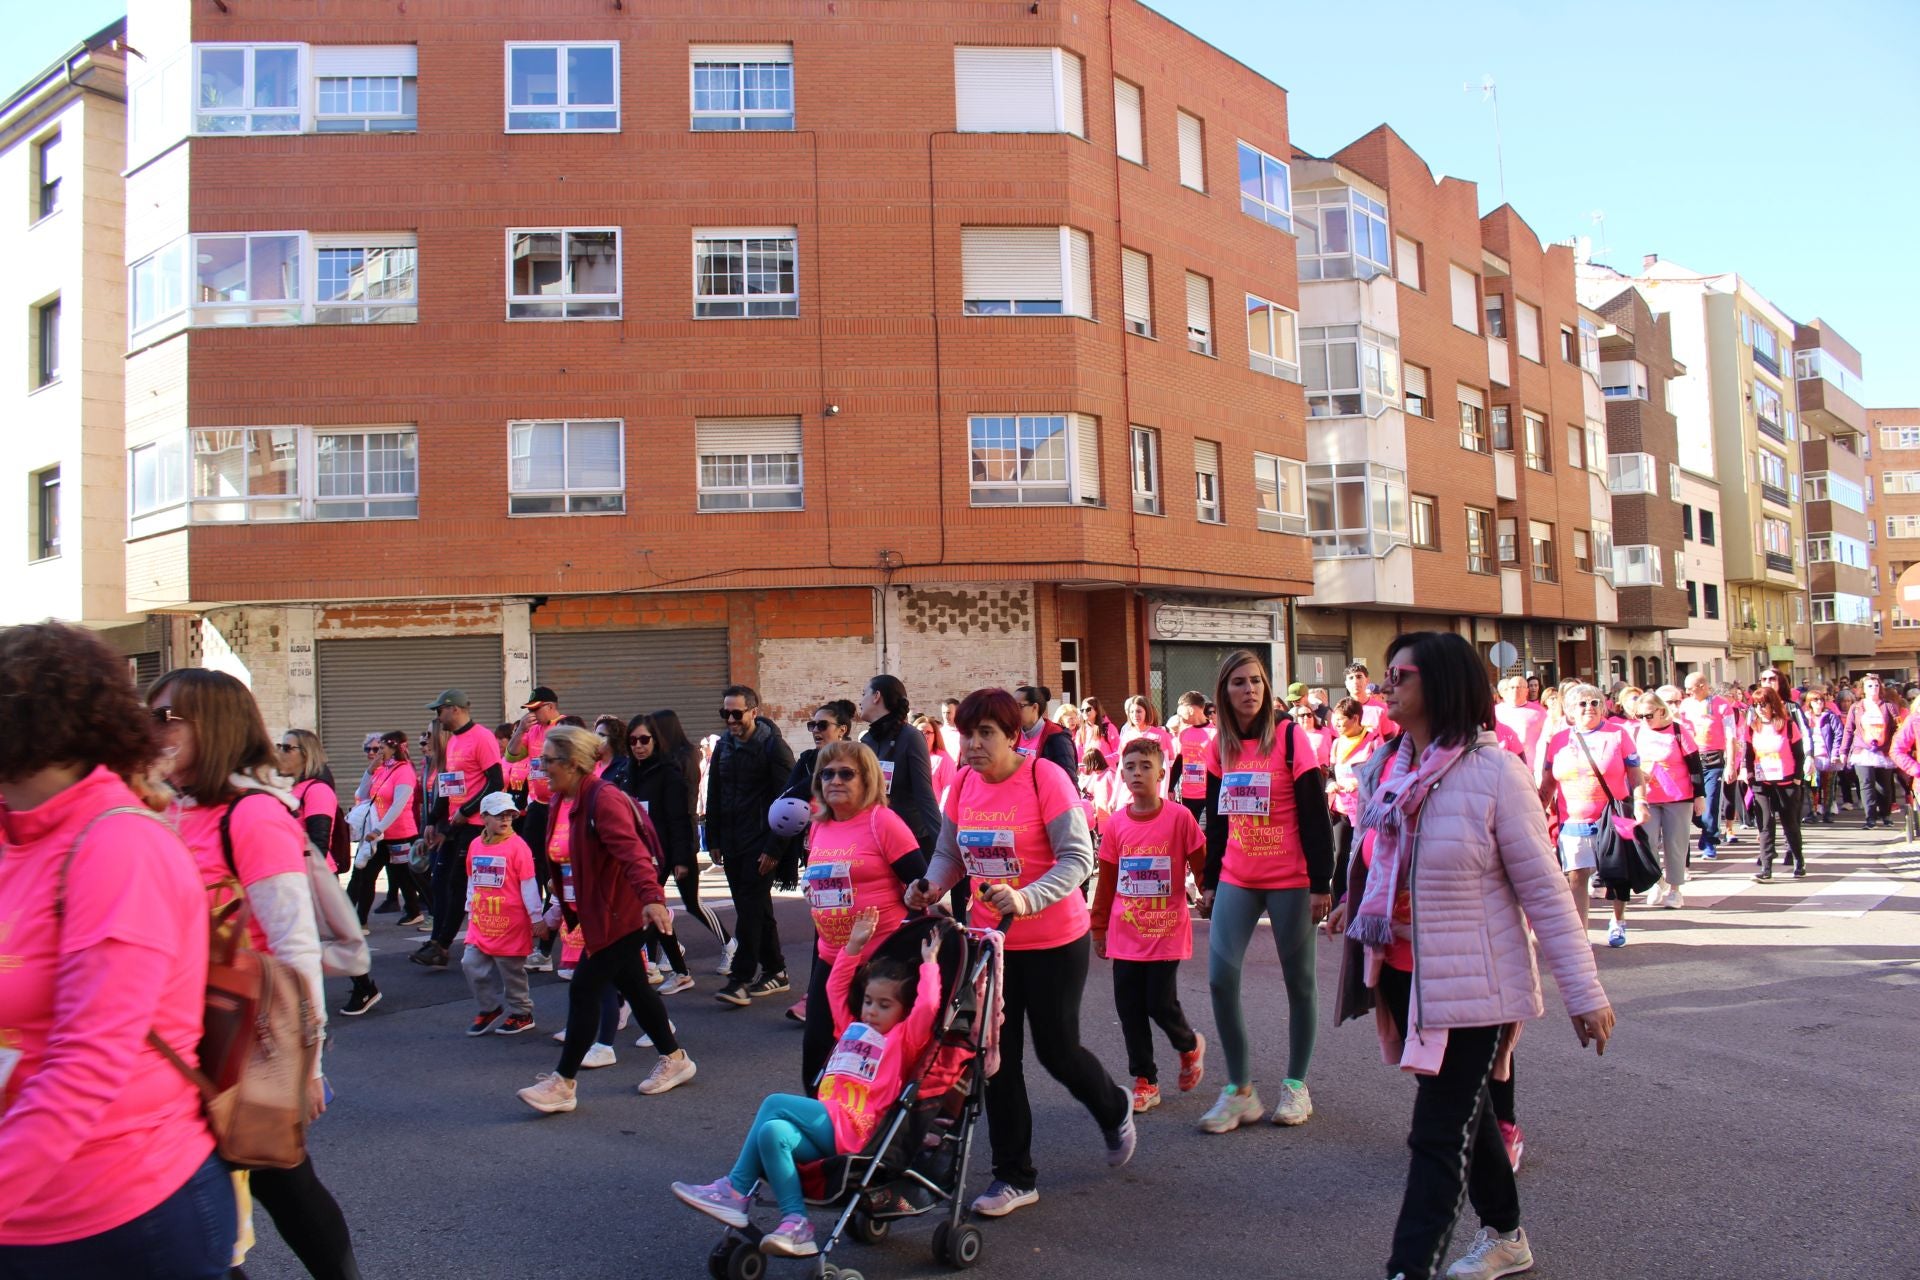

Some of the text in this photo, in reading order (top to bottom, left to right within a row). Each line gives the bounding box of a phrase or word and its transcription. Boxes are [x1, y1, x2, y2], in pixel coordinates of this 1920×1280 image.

[290, 645, 311, 653] ALQUILA
[1235, 758, 1272, 770] asanvi
[1235, 787, 1257, 797] 1874
[963, 805, 1018, 822] Drasanvi
[1241, 825, 1285, 837] Carrera
[1252, 834, 1285, 846] Mujer
[810, 843, 857, 857] Drasanvi
[977, 847, 1008, 859] 5343
[1122, 841, 1169, 856] Drasanvi
[1136, 870, 1160, 880] 1875
[818, 879, 844, 890] 5345
[1137, 909, 1178, 920] Carrera
[1148, 918, 1177, 929] Mujer
